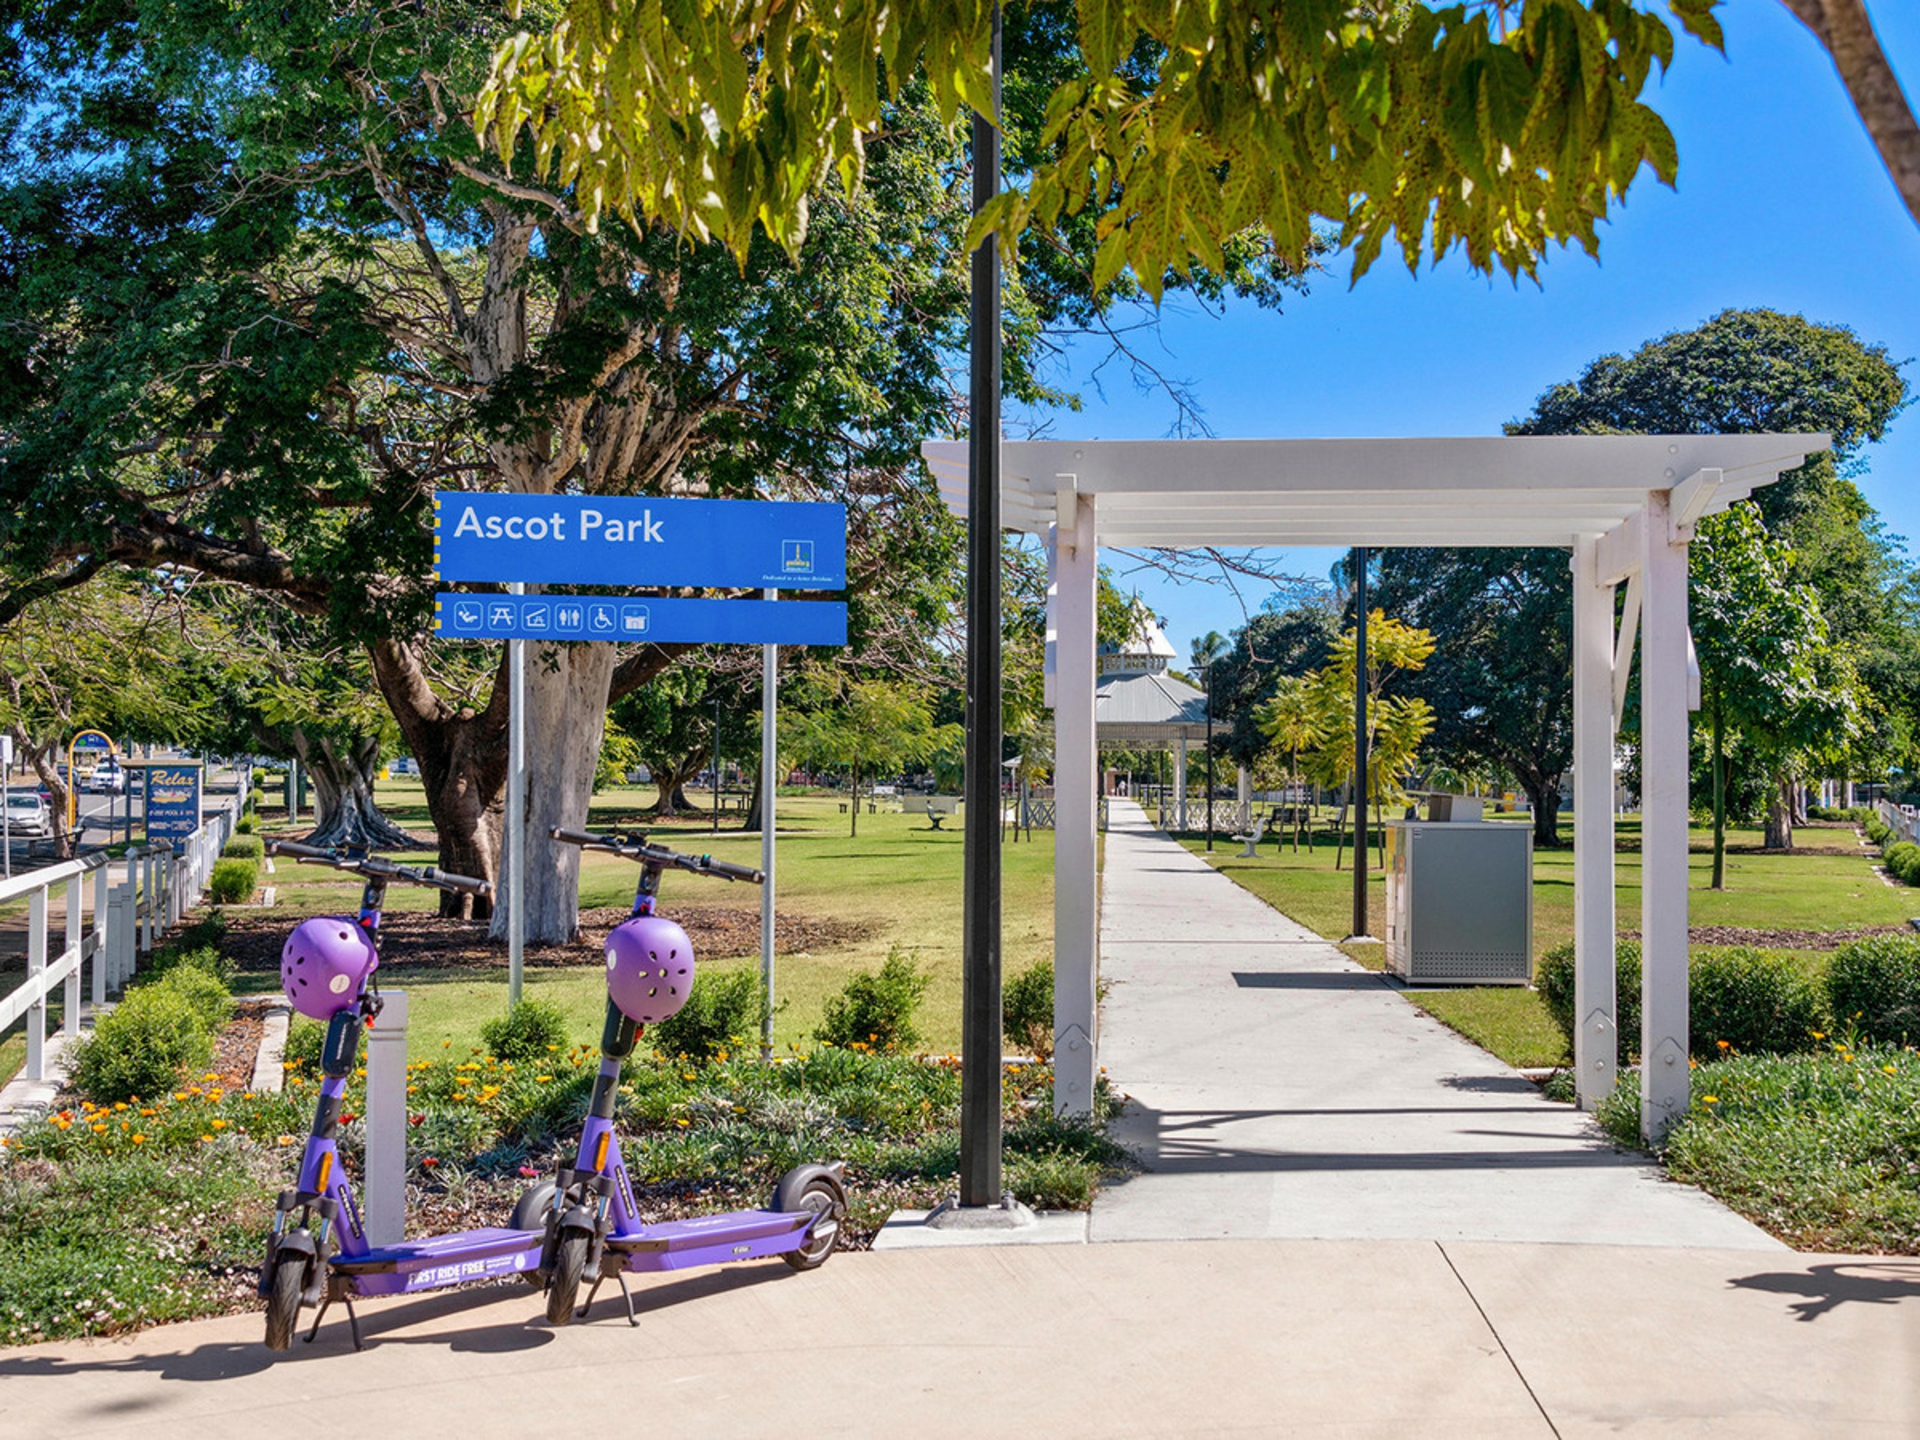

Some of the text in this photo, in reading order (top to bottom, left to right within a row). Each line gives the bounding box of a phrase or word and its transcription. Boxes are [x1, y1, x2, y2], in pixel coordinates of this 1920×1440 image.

[453, 506, 664, 542] Ascot Park
[150, 769, 194, 785] Relax
[408, 1268, 436, 1286] FIRST
[437, 1264, 460, 1279] RIDE
[462, 1260, 486, 1276] FREE
